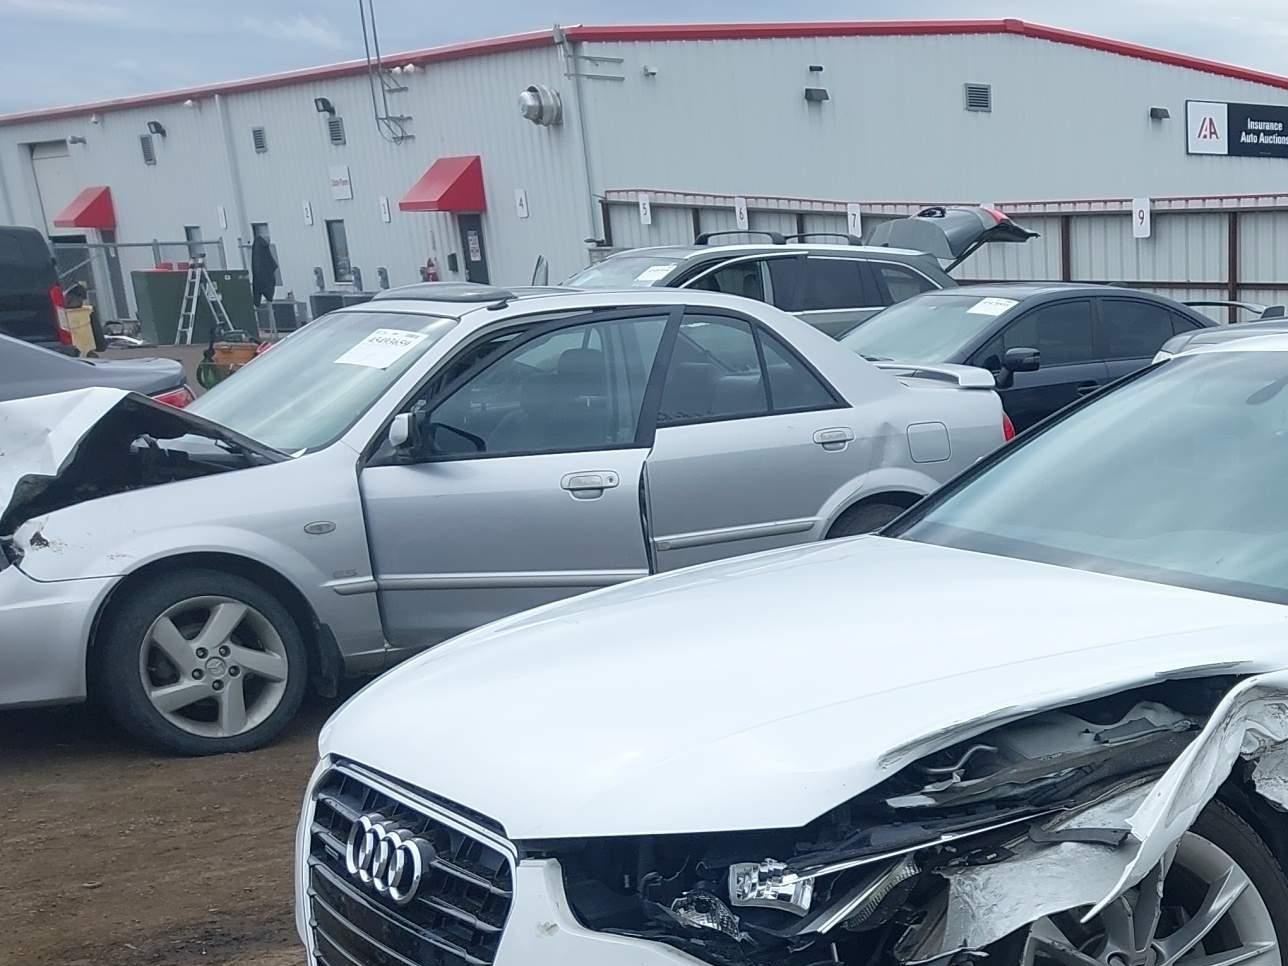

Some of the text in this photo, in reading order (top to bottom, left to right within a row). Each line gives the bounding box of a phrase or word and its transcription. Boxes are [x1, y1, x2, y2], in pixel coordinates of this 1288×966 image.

[1247, 118, 1283, 131] Insurance
[1240, 132, 1258, 144] Auto
[518, 196, 524, 209] 4
[642, 202, 648, 216] 5
[739, 207, 745, 221] 6
[851, 213, 857, 228] 7
[1138, 209, 1145, 225] 9
